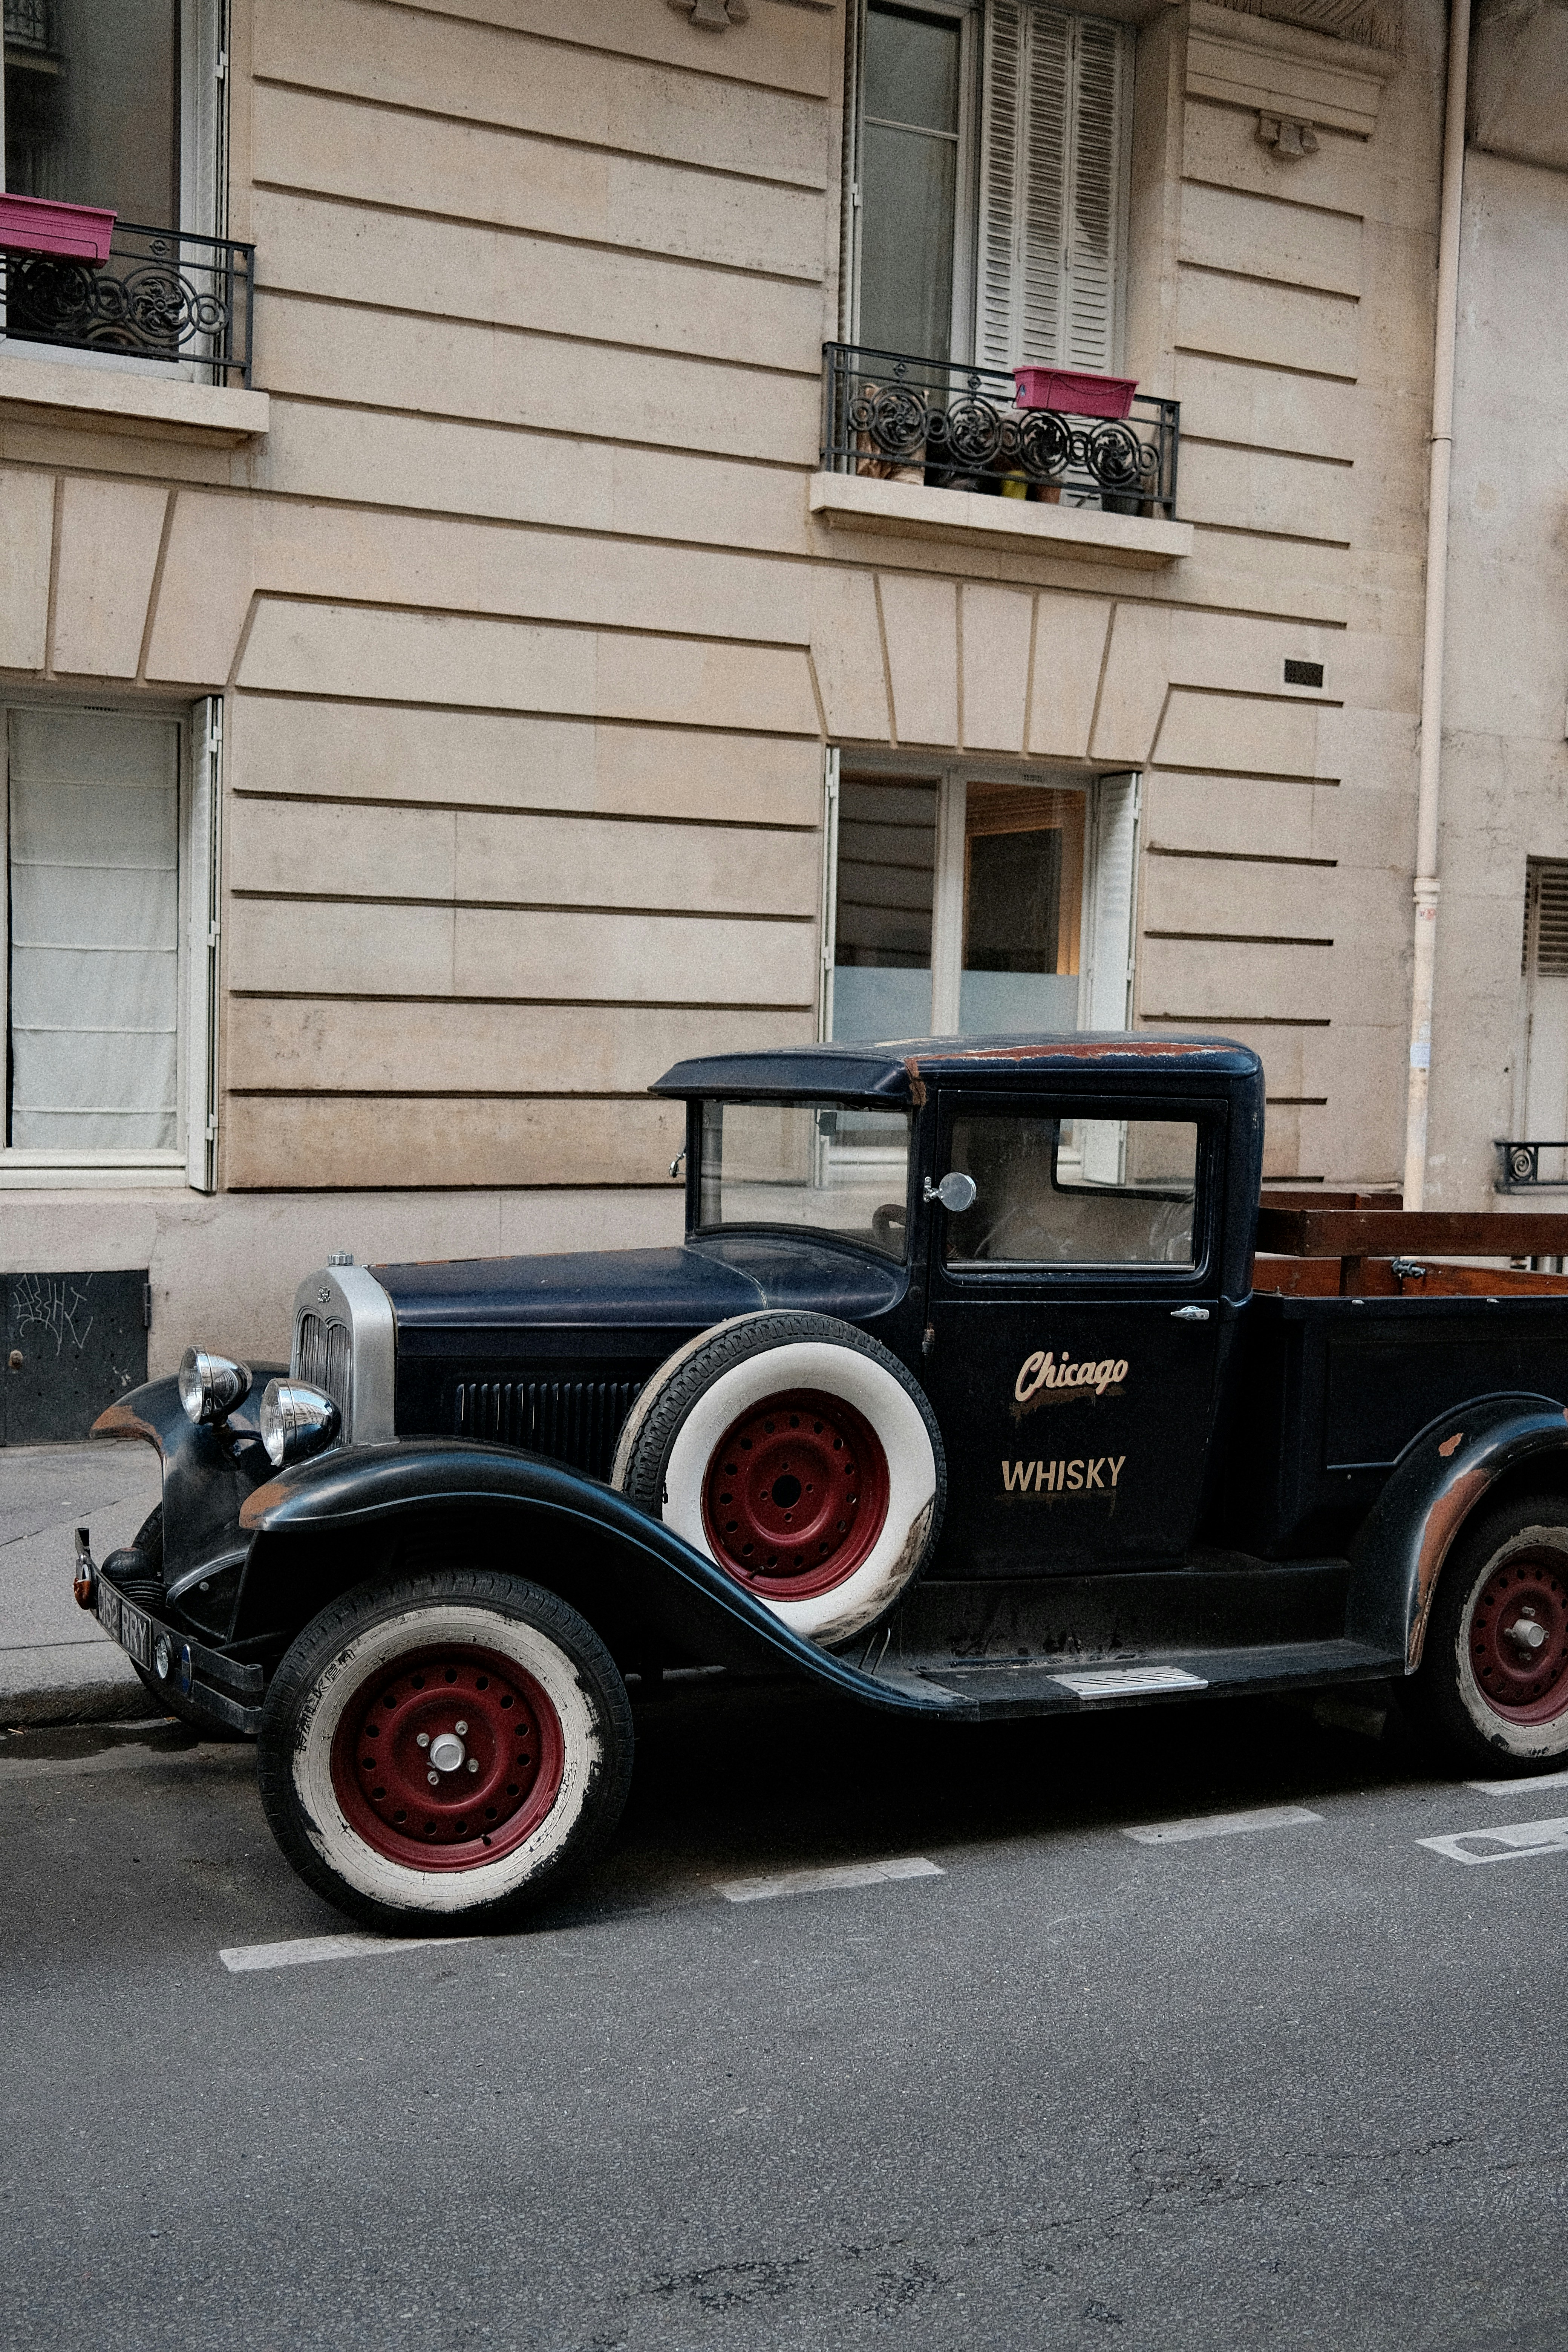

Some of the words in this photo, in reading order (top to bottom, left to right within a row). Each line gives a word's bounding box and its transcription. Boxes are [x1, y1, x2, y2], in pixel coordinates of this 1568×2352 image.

[1015, 1351, 1129, 1401] Chicago
[1002, 1456, 1126, 1491] WHISKY
[122, 1605, 147, 1660] RRY
